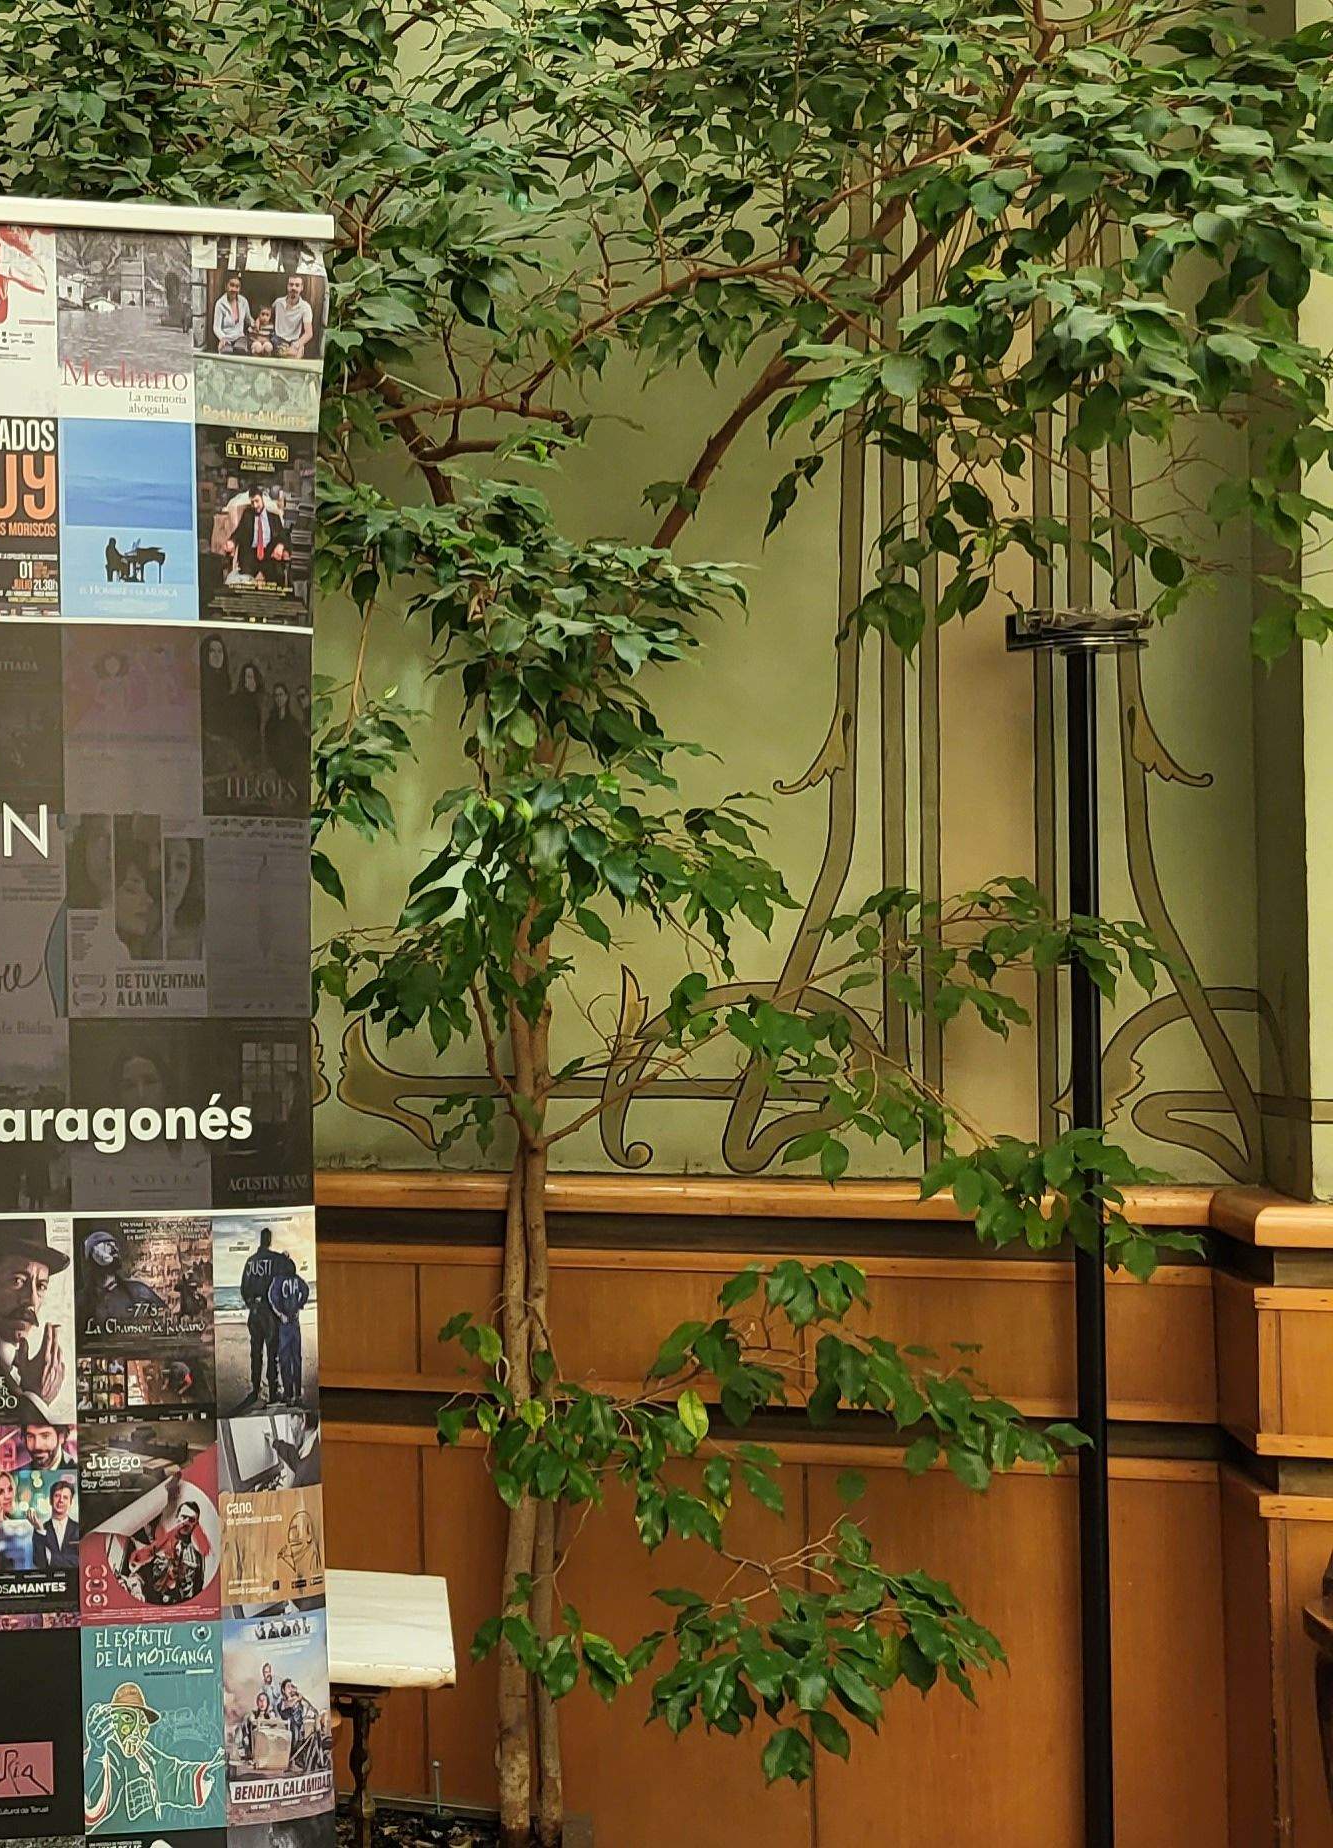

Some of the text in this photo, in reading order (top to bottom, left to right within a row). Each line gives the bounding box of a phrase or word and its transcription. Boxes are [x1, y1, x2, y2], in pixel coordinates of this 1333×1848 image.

[61, 356, 188, 391] Mediano
[129, 392, 187, 404] La memoria
[128, 404, 170, 416] ahogada
[227, 444, 287, 459] EL TRASTERO
[8, 521, 56, 537] MORISCOS
[19, 561, 33, 579] 01
[116, 974, 206, 989] DE TU VENTANA
[117, 991, 125, 1006] A
[128, 991, 143, 1006] LA
[245, 1259, 272, 1277] JUSTI
[85, 1317, 102, 1335] La
[105, 1318, 151, 1334] Chanson
[86, 1453, 141, 1472] Juego
[95, 1625, 172, 1650] EL ESPÍRITU
[96, 1644, 214, 1668] DE LA MOJIGANGA
[234, 1774, 331, 1801] BENDITA CALAMIDAD
